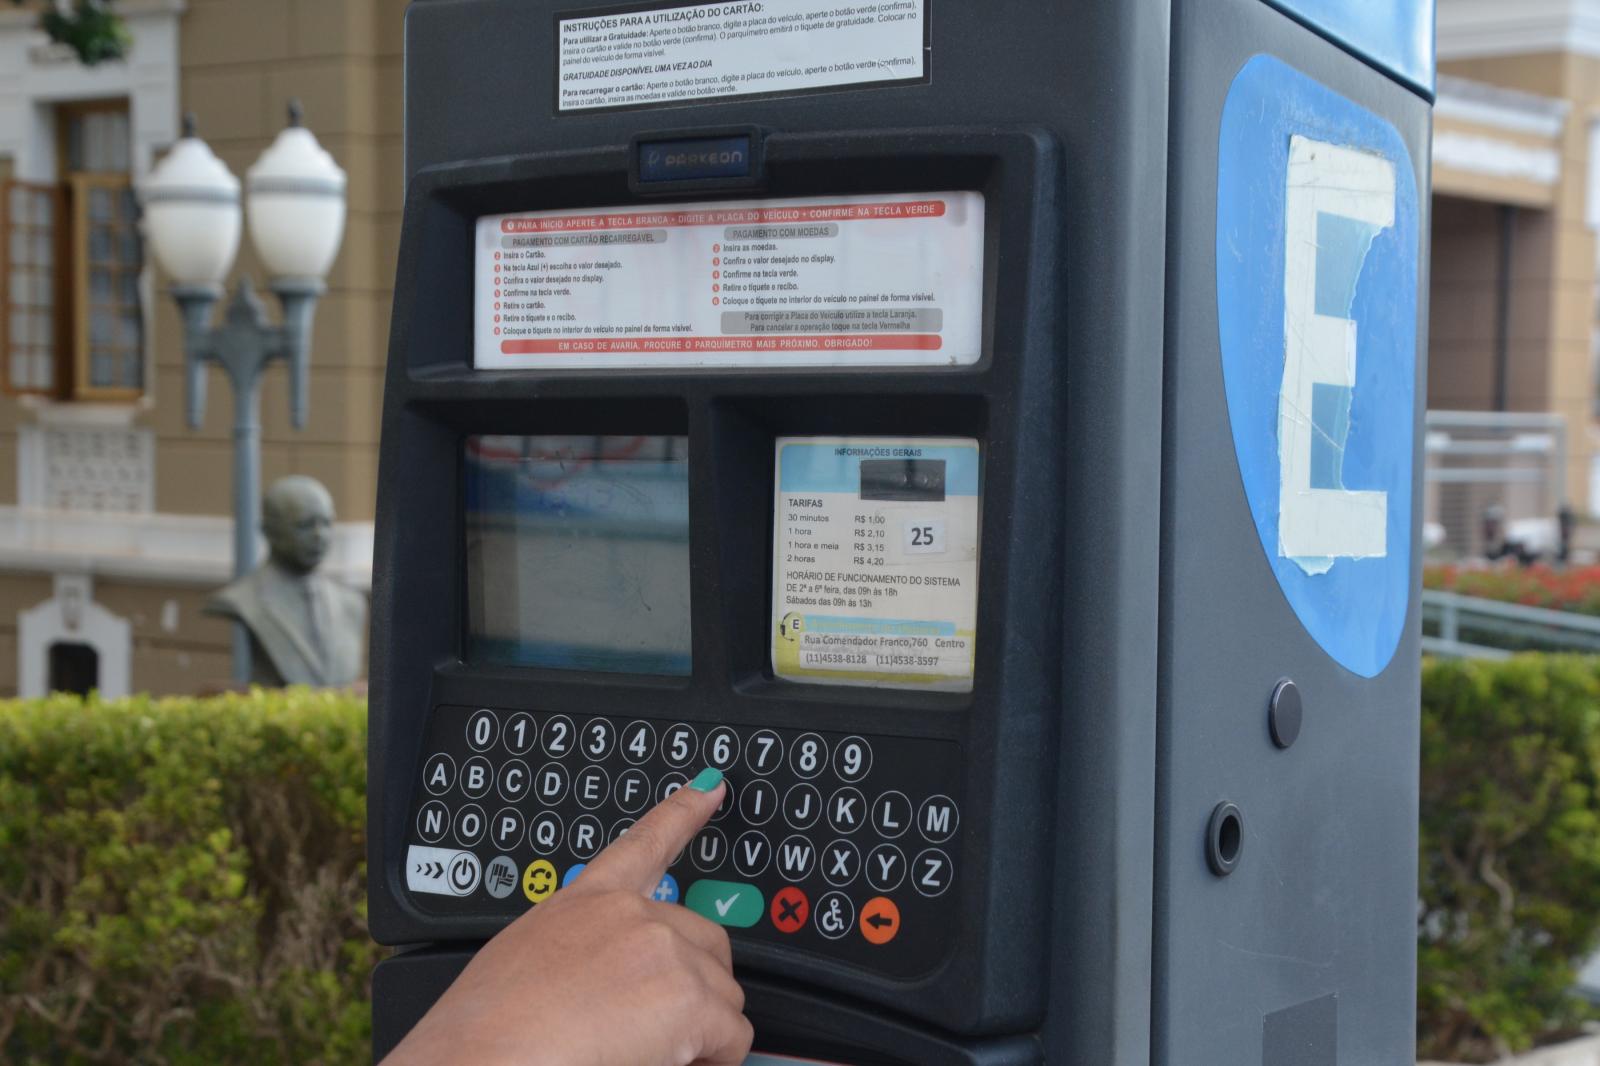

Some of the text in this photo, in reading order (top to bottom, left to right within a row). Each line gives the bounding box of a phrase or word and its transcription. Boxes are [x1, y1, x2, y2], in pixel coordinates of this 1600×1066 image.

[563, 1, 764, 33] INSTRUÇÕES PARA A UTILIZAÇÃO DO CARTÃO:
[562, 35, 579, 45] Para
[579, 33, 602, 44] utilizar
[608, 29, 648, 41] Gratuidade:
[563, 58, 712, 81] GRATUIDADE DISPONÍVEL UMA VEZ AO DIA
[562, 87, 578, 96] Para
[578, 86, 614, 97] recarregar
[620, 82, 645, 92] cartão:
[517, 204, 934, 230] PARA INÍCIO APERTE A TECLA BRANCA DIGITE A PLACA DO VEÍCULO CONFIRME NA TECLA VERDE
[512, 230, 654, 247] PAGAMENTO COM CARTÃO RECARREGÁVEL
[732, 226, 829, 239] PAGAMENTO COM MOEDAS
[722, 243, 741, 252] Insira
[750, 242, 778, 251] moedas.
[722, 255, 746, 265] Confira
[752, 255, 769, 264] valor
[769, 254, 799, 265] desejado
[800, 255, 809, 263] no
[810, 253, 836, 264] display.
[722, 269, 751, 279] Confirme
[761, 268, 778, 278] tecla
[778, 268, 798, 277] verde.
[558, 341, 569, 350] EM
[572, 341, 594, 350] CASO
[596, 340, 607, 350] DE
[643, 340, 681, 349] PROCURE
[684, 340, 691, 349] O
[694, 338, 753, 350] PARQUÍMETRO
[755, 339, 776, 348] MAIS
[824, 338, 872, 347] OBRIGADO!
[1278, 135, 1396, 558] E
[834, 447, 922, 457] INFORMAÇÕES GERAIS
[789, 499, 823, 507] TARIFAS
[799, 514, 829, 522] minutos
[869, 516, 885, 524] 1,00
[868, 530, 884, 538] 2,10
[911, 527, 934, 546] 25
[854, 543, 884, 552] R$ 3,15
[794, 555, 815, 563] horas
[854, 557, 884, 566] R$ 4,20
[787, 571, 961, 586] HORÁRIO DE FUNCIONAMENTO DO SISTEMA
[824, 585, 841, 595] feira,
[843, 586, 856, 595] das
[858, 587, 871, 595] 09h
[884, 588, 897, 596] 18h
[786, 595, 817, 605] Sábados
[818, 597, 831, 605] das
[833, 598, 846, 606] 09h
[859, 599, 872, 607] 13h
[792, 619, 800, 629] E
[805, 636, 965, 648] Rua Comendador Franco,760 Centro
[806, 653, 867, 664] (11)4538-8128
[474, 716, 862, 775] 0 1 2 3 4 5 6 7 8 9
[430, 762, 447, 787] A
[467, 765, 485, 789] B
[505, 768, 523, 793] C
[543, 771, 562, 796] D
[583, 775, 601, 800] E
[624, 778, 641, 802] F
[754, 789, 763, 815] I
[795, 793, 811, 819] J
[836, 797, 857, 824] K
[882, 801, 899, 828] L
[926, 805, 950, 833] M
[424, 809, 442, 834] N
[461, 813, 480, 838] O
[500, 816, 517, 841] P
[536, 820, 556, 847] Q
[576, 824, 595, 850] R
[700, 836, 718, 862] U
[744, 840, 763, 866] V
[784, 844, 811, 872] W
[830, 849, 851, 877] X
[877, 854, 897, 881] Y
[921, 859, 942, 887] Z
